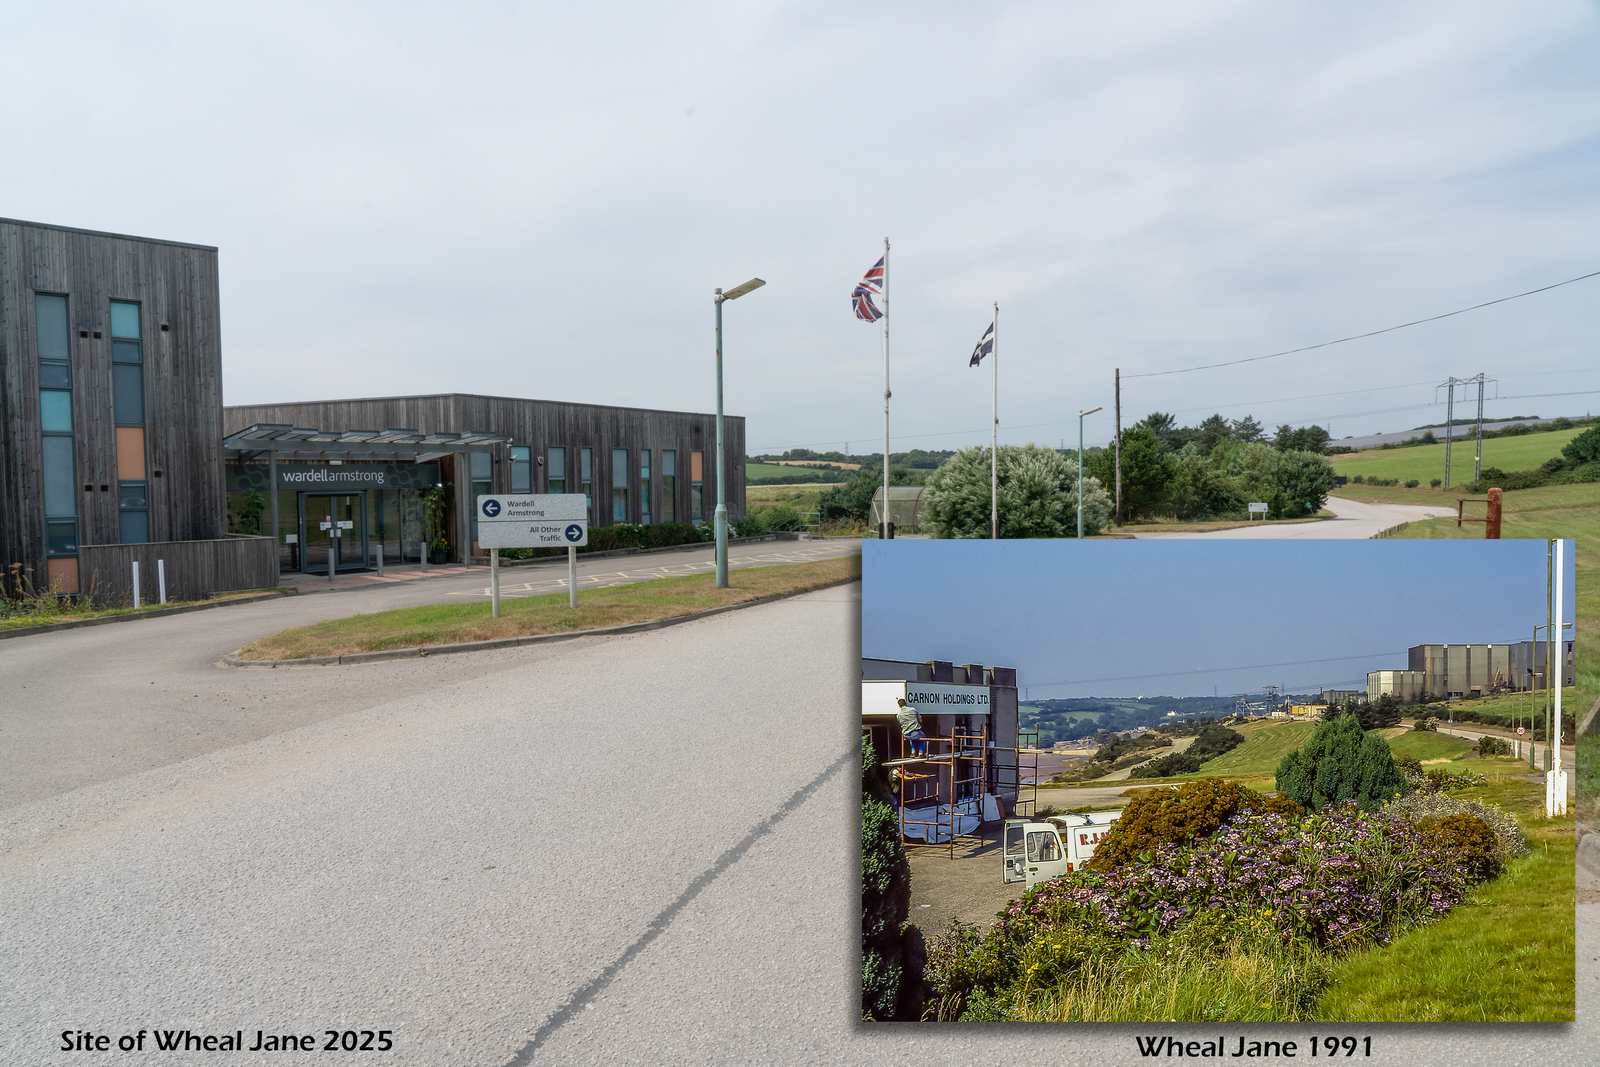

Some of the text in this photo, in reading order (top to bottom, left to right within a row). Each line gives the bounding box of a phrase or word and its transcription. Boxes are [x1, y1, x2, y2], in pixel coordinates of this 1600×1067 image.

[507, 509, 545, 517] Armstrong
[907, 692, 940, 704] CARNON
[943, 693, 975, 705] HOLDINGS
